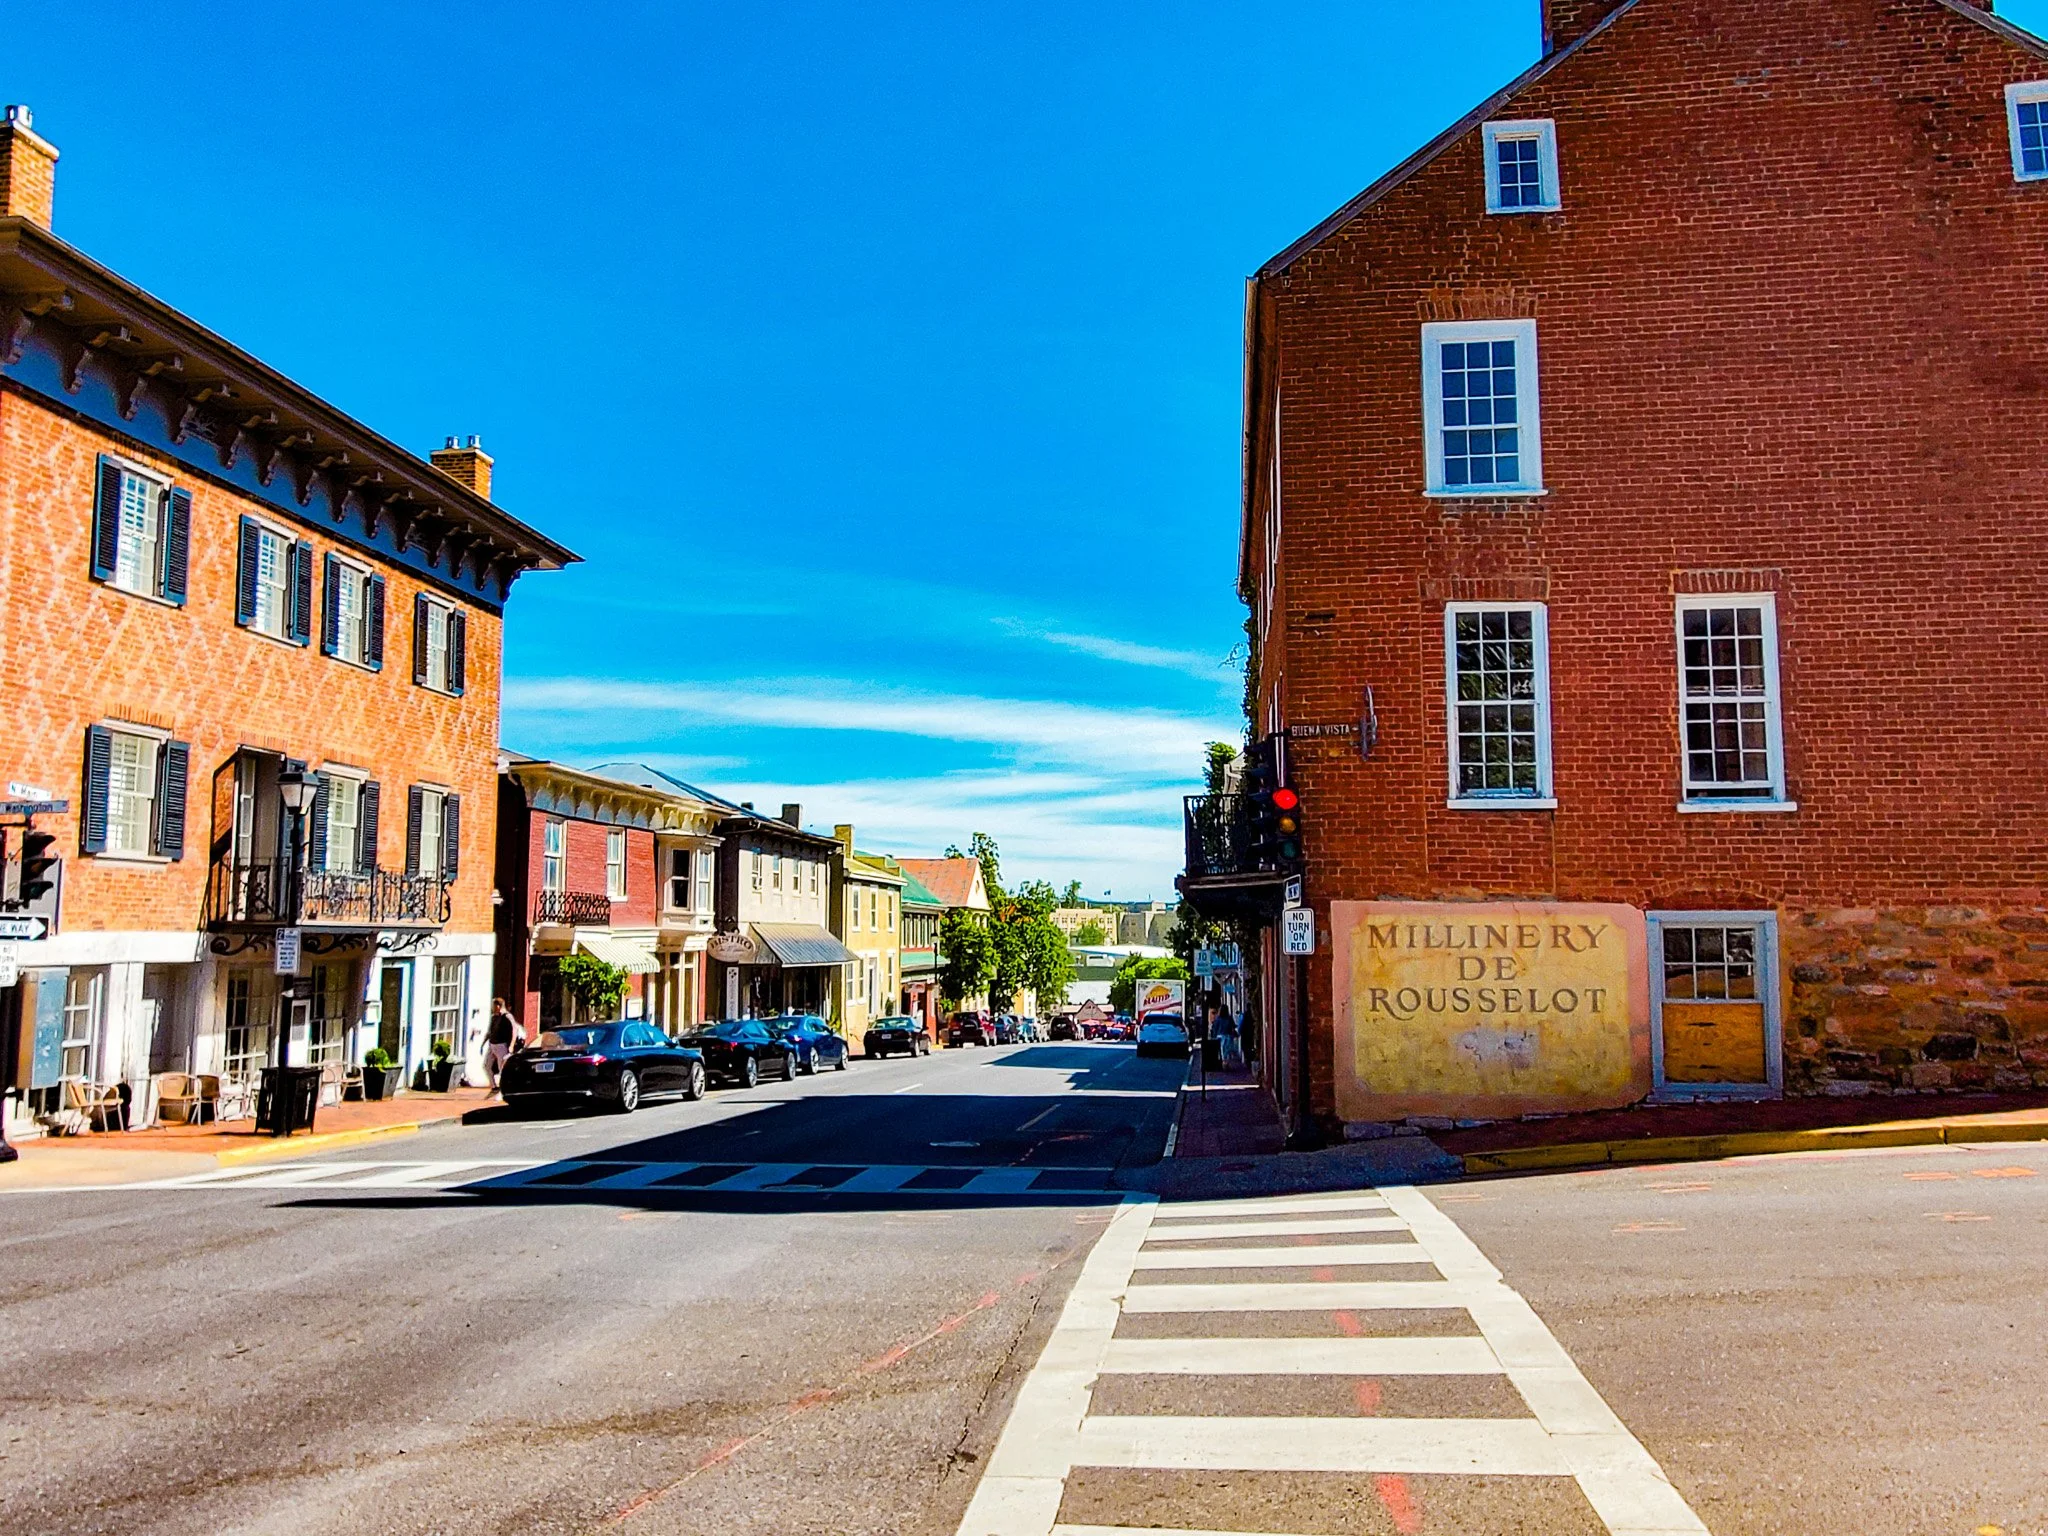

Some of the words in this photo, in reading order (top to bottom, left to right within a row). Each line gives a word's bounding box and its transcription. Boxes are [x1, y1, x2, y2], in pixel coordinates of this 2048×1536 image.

[1291, 725, 1320, 737] BUENA
[1324, 723, 1350, 735] VISTA
[1292, 912, 1304, 921] NO
[11, 923, 29, 933] WAY
[1288, 922, 1309, 931] TURN
[709, 935, 752, 950] BISTRO
[1293, 932, 1305, 941] ON
[1367, 924, 1609, 952] MILLINERY
[1290, 942, 1308, 951] RED
[1457, 956, 1519, 981] DE
[1369, 987, 1607, 1021] ROUSSELOT
